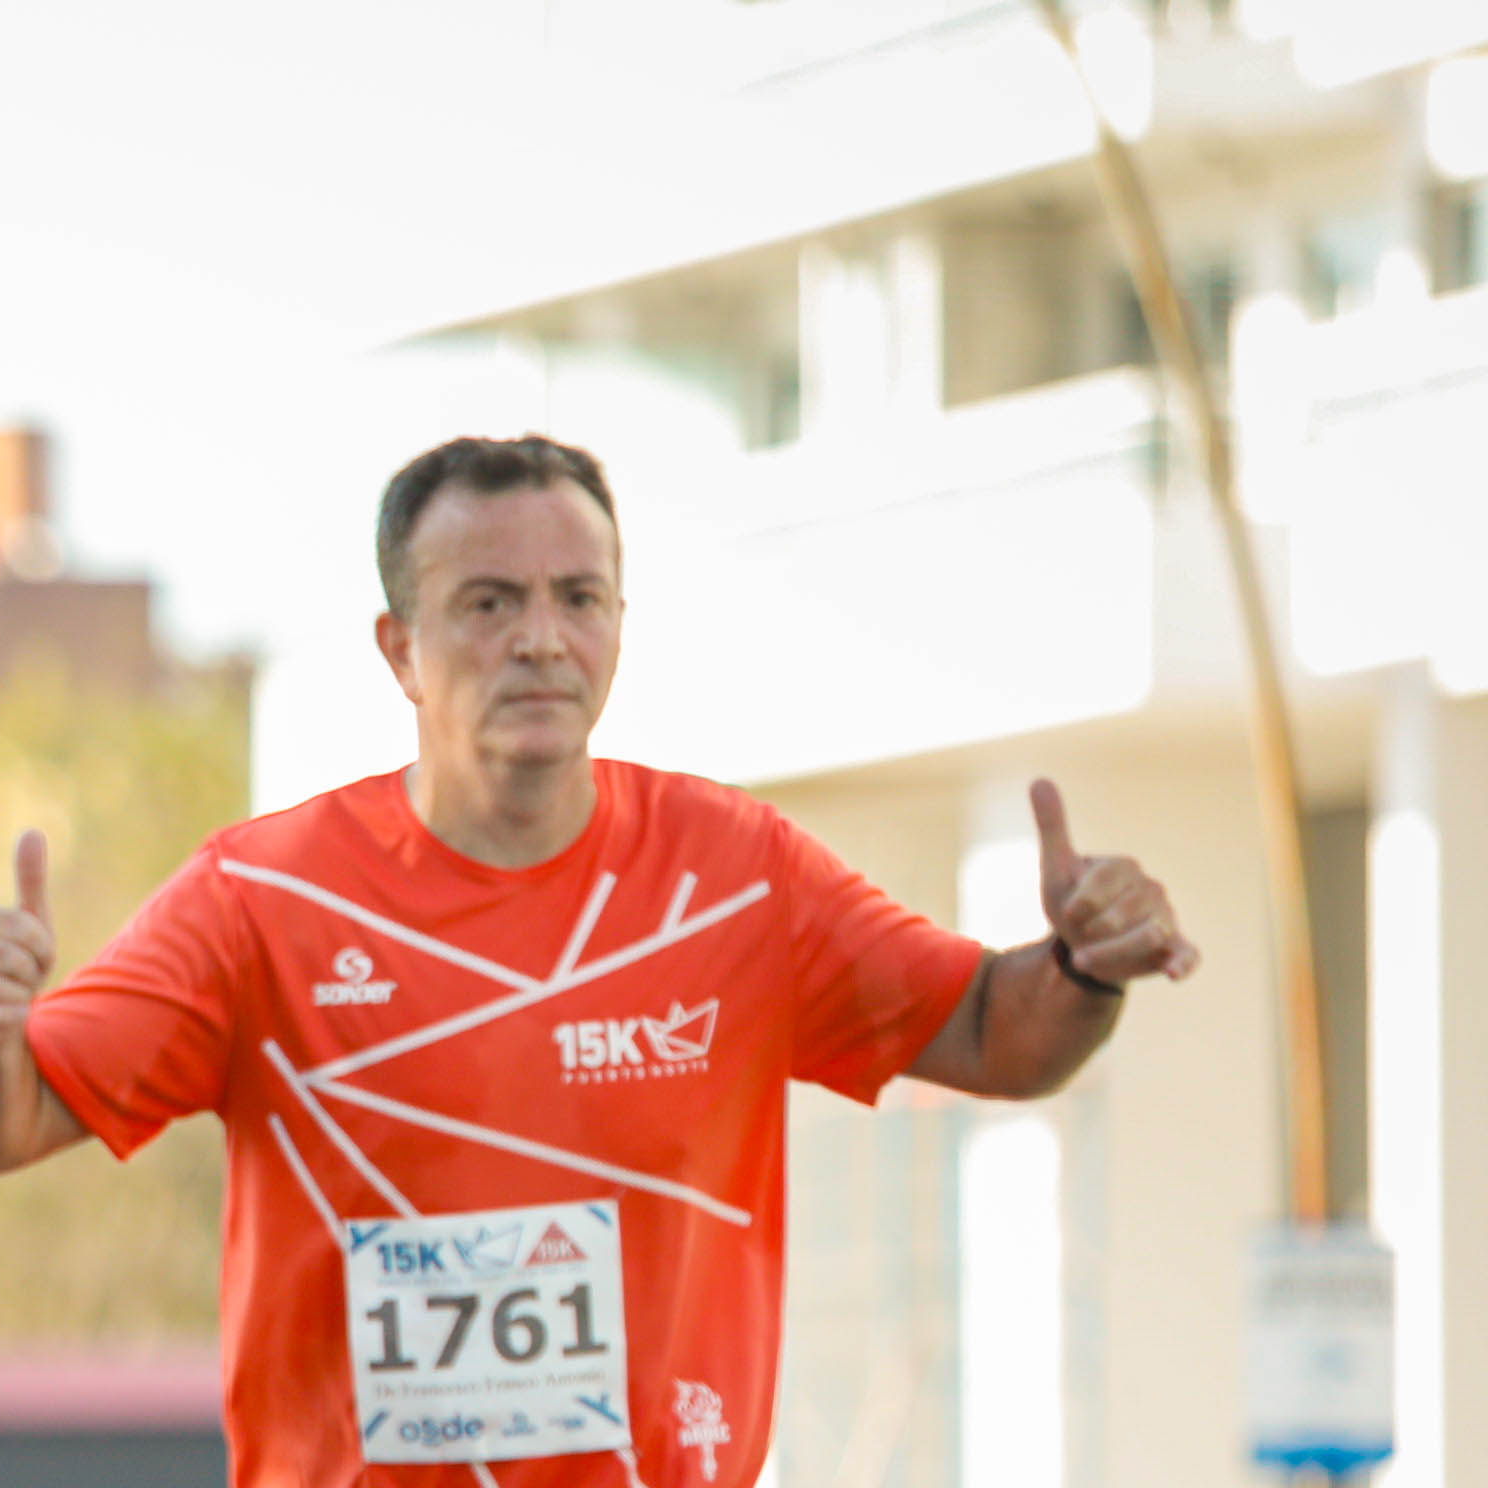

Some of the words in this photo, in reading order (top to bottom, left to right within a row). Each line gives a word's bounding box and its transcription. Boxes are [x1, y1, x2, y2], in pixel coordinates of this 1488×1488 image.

[553, 1018, 644, 1069] 15K
[377, 1239, 445, 1273] 15K
[366, 1283, 608, 1373] 1761
[400, 1411, 484, 1444] osde
